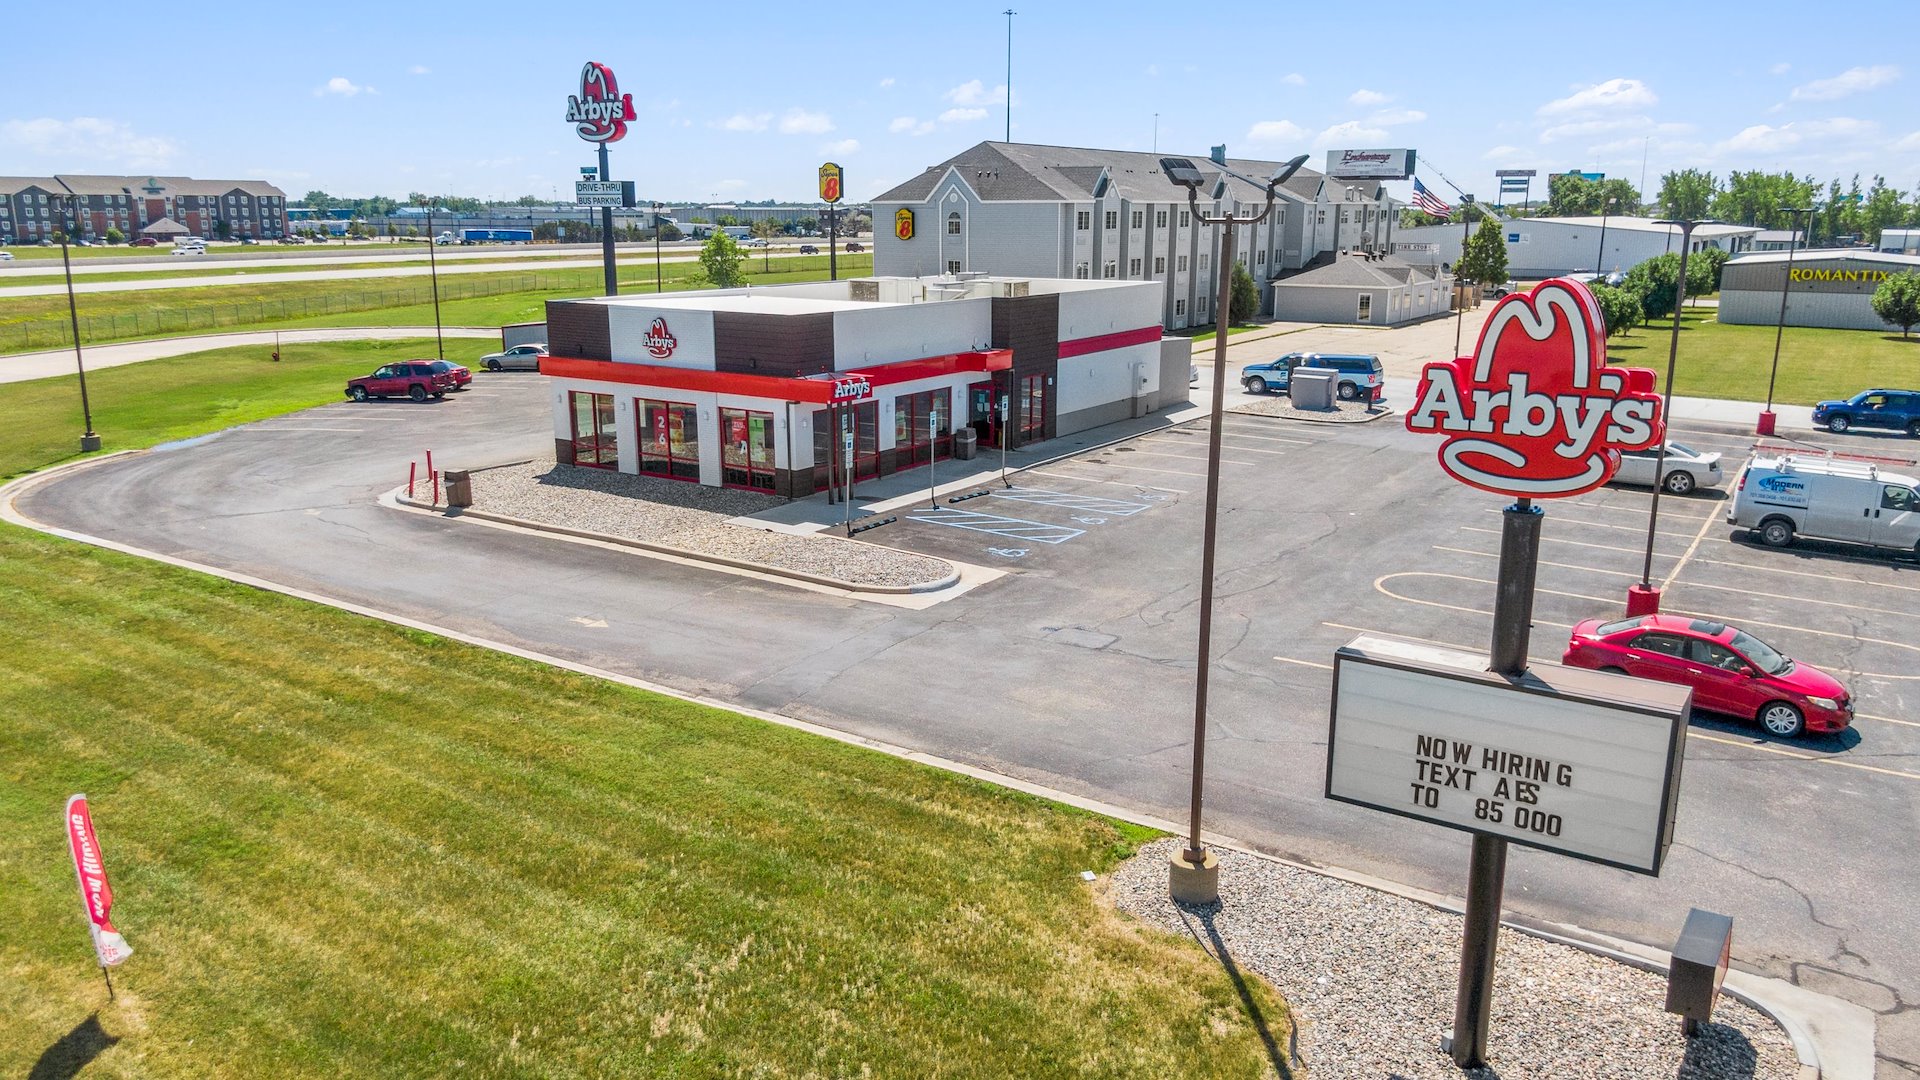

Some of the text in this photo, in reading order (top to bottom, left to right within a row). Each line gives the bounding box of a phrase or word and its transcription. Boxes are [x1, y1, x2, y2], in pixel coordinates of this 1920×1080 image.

[566, 93, 624, 127] Arby's
[577, 183, 621, 192] DRIVE-THRU
[824, 177, 838, 199] 8
[578, 197, 621, 205] BUS PARKING
[900, 220, 911, 237] 8
[1790, 268, 1889, 282] ROMANTIX
[643, 333, 674, 351] Arby's
[834, 377, 870, 399] Arby's
[1411, 368, 1655, 458] Arby's
[1416, 734, 1572, 787] NOW HIRING
[1415, 759, 1477, 791] TEXT
[1411, 782, 1439, 809] TO
